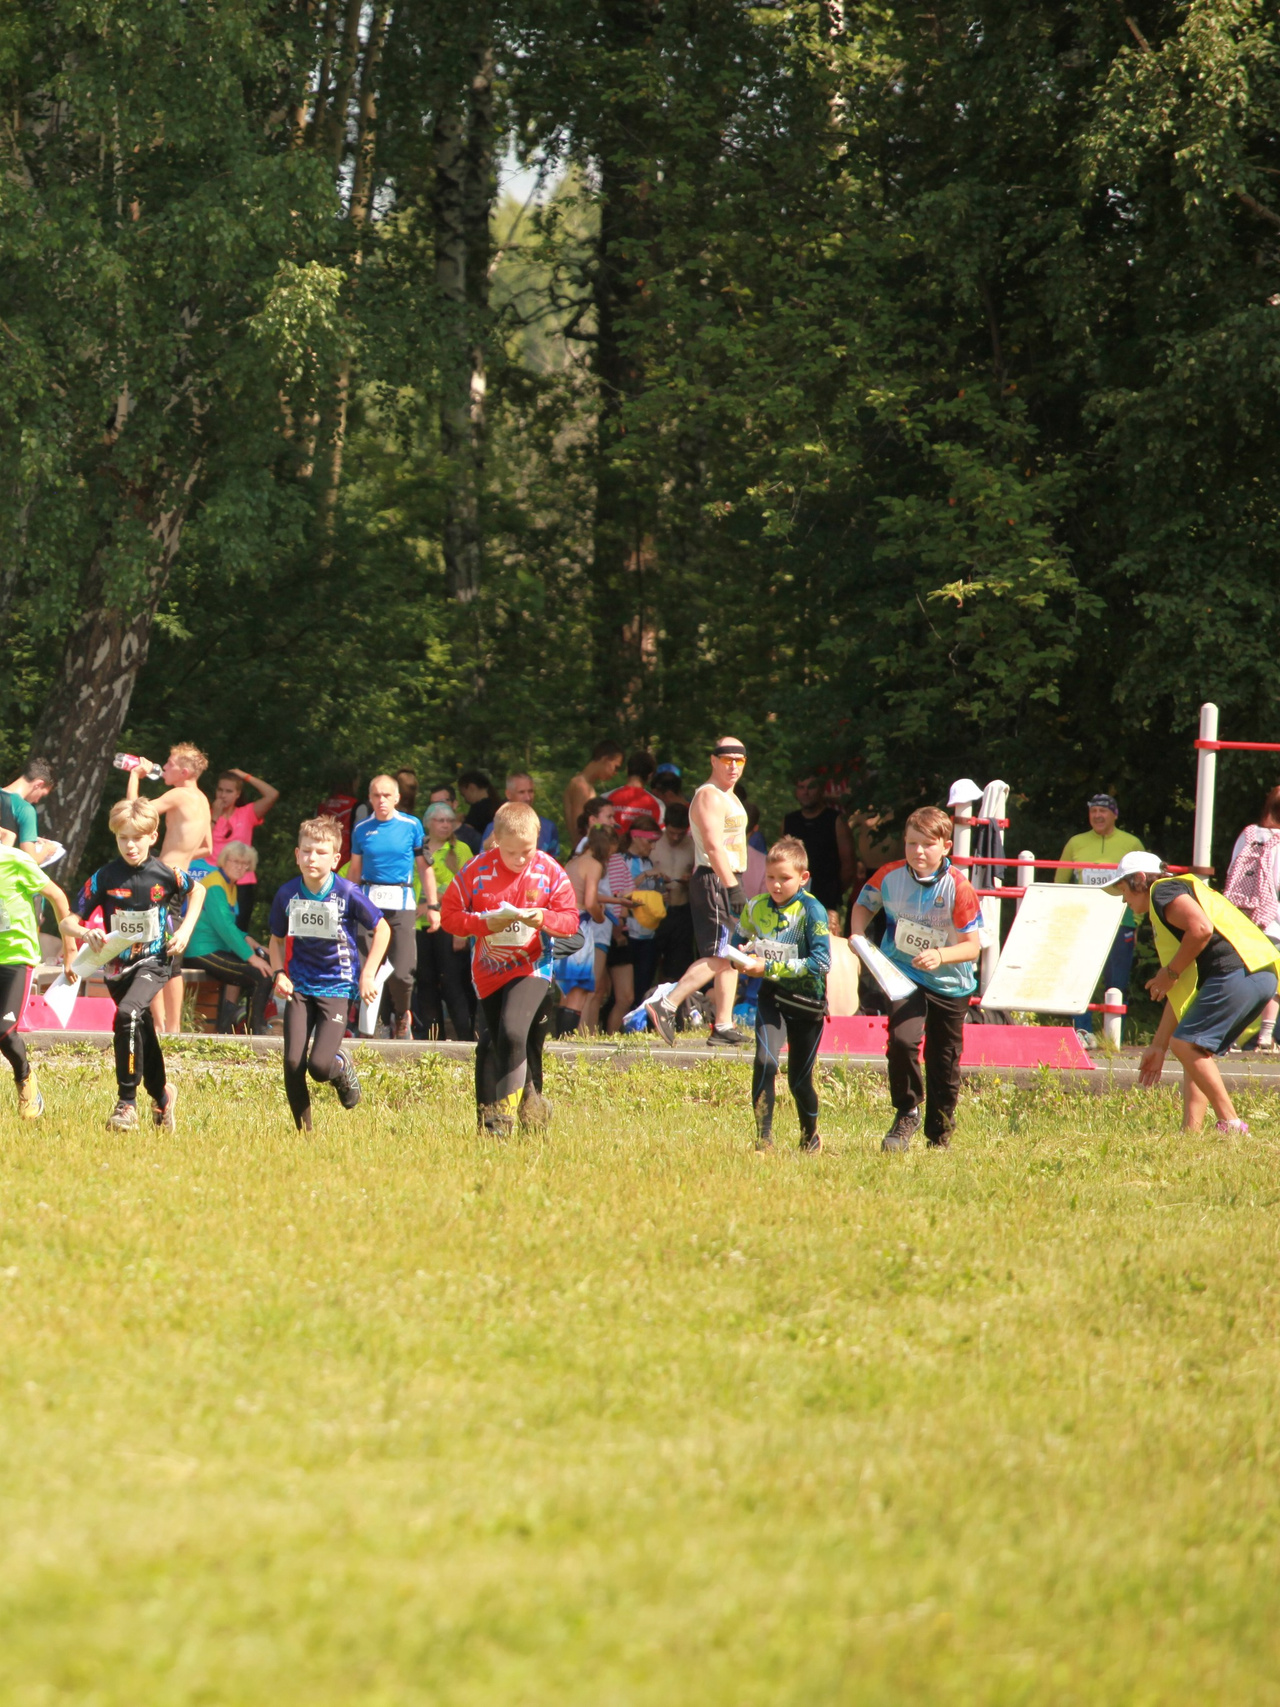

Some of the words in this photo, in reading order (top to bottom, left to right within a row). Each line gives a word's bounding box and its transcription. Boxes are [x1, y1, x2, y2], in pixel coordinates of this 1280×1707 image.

[1090, 876, 1108, 886] 930
[301, 912, 324, 926] 656
[120, 922, 144, 933] 655
[906, 934, 931, 950] 658
[764, 949, 784, 962] 637
